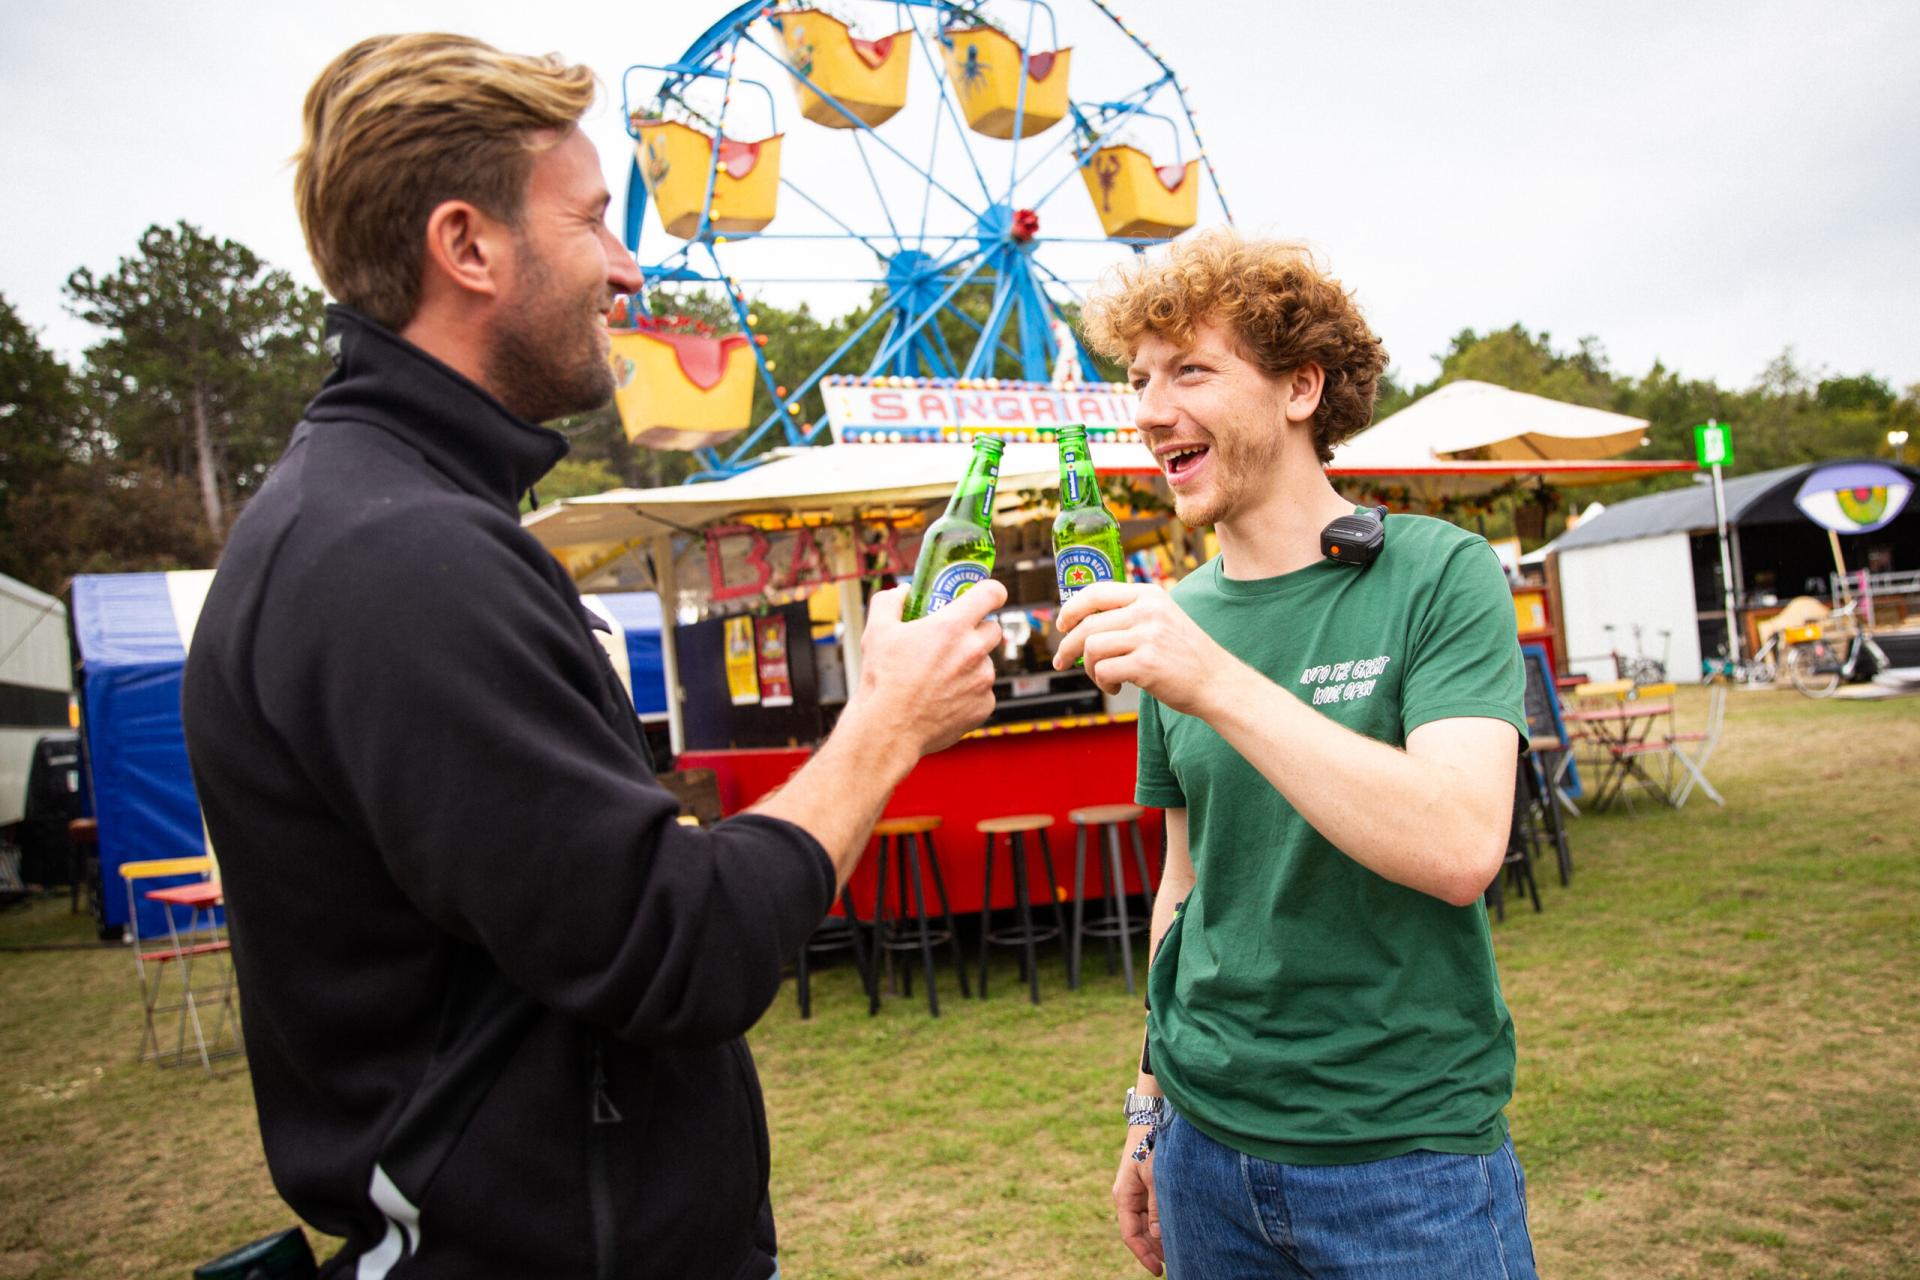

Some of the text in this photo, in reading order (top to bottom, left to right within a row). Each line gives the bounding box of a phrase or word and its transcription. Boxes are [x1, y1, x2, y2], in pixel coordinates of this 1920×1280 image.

[704, 517, 899, 602] BAR
[1091, 559, 1106, 577] BEER
[943, 571, 979, 592] HEINEKEN
[1300, 656, 1391, 684] INTO THE GREAT
[1313, 679, 1376, 705] WIDE OPEN
